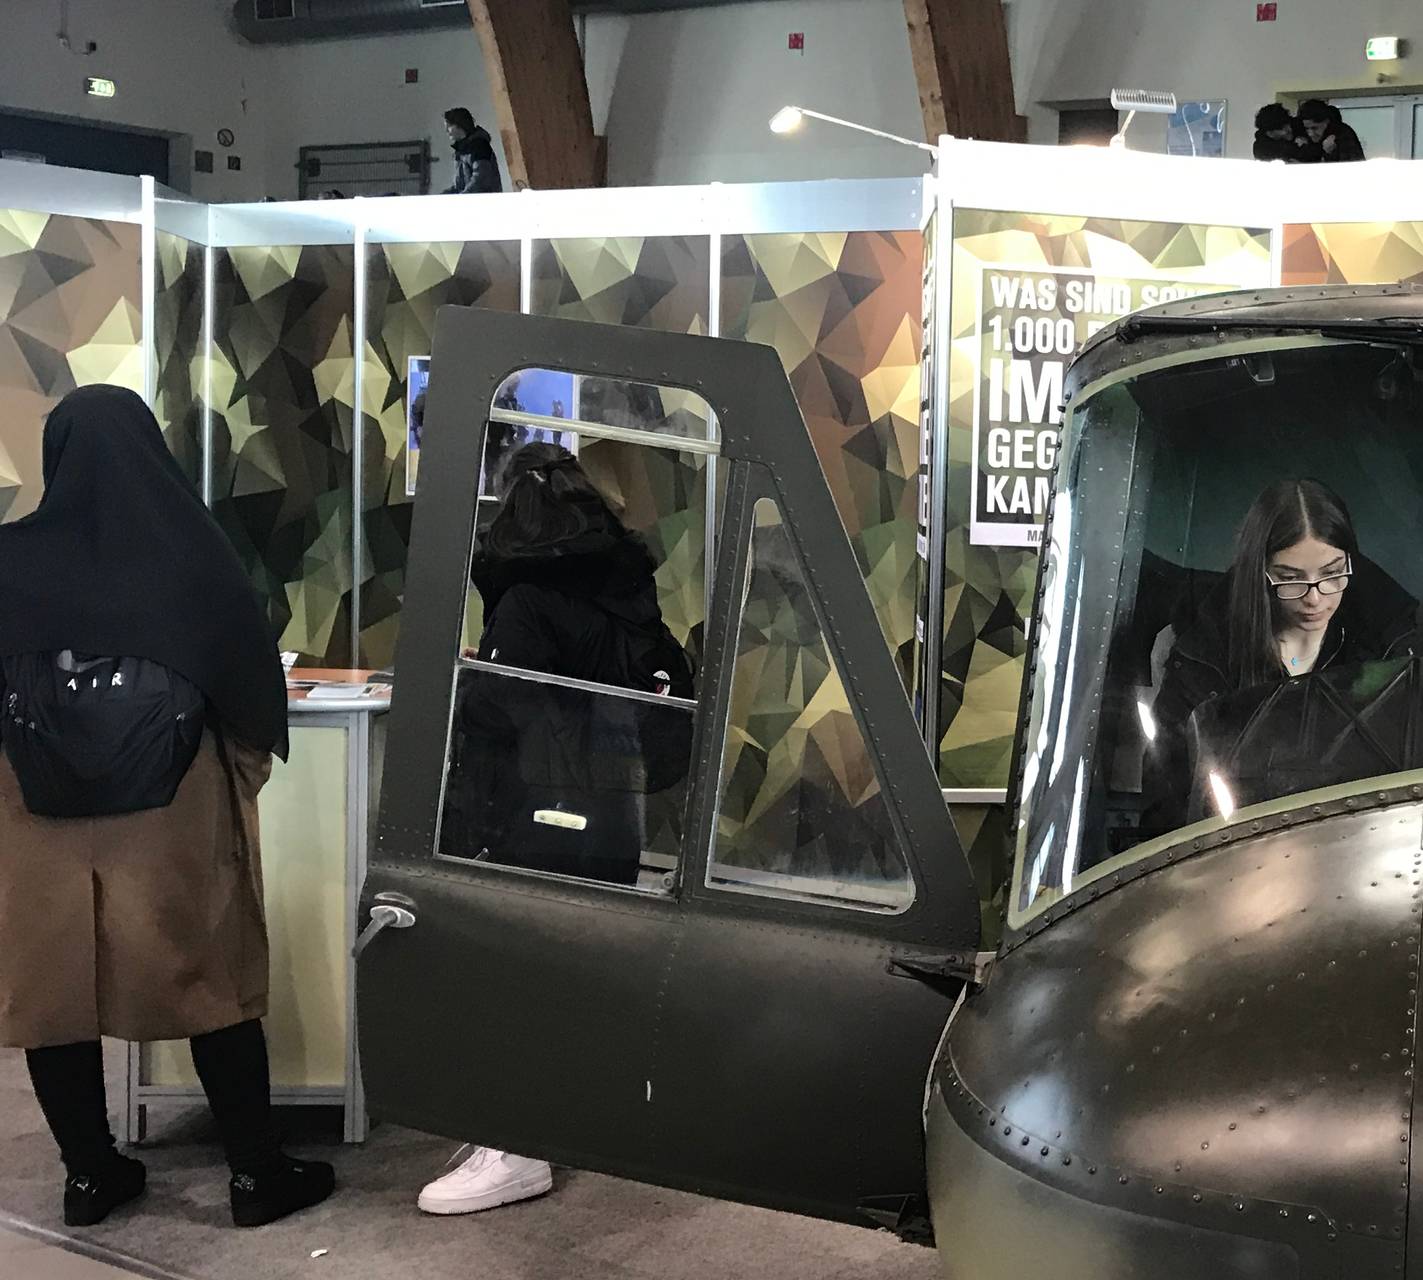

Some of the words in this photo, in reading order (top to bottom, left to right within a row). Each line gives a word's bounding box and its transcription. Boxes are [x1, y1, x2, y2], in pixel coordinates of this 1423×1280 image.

[991, 275, 1057, 313] WAS
[1065, 279, 1131, 315] SIND
[988, 314, 1075, 355] 1.000
[988, 357, 1063, 424] IM
[67, 672, 122, 691] AIR
